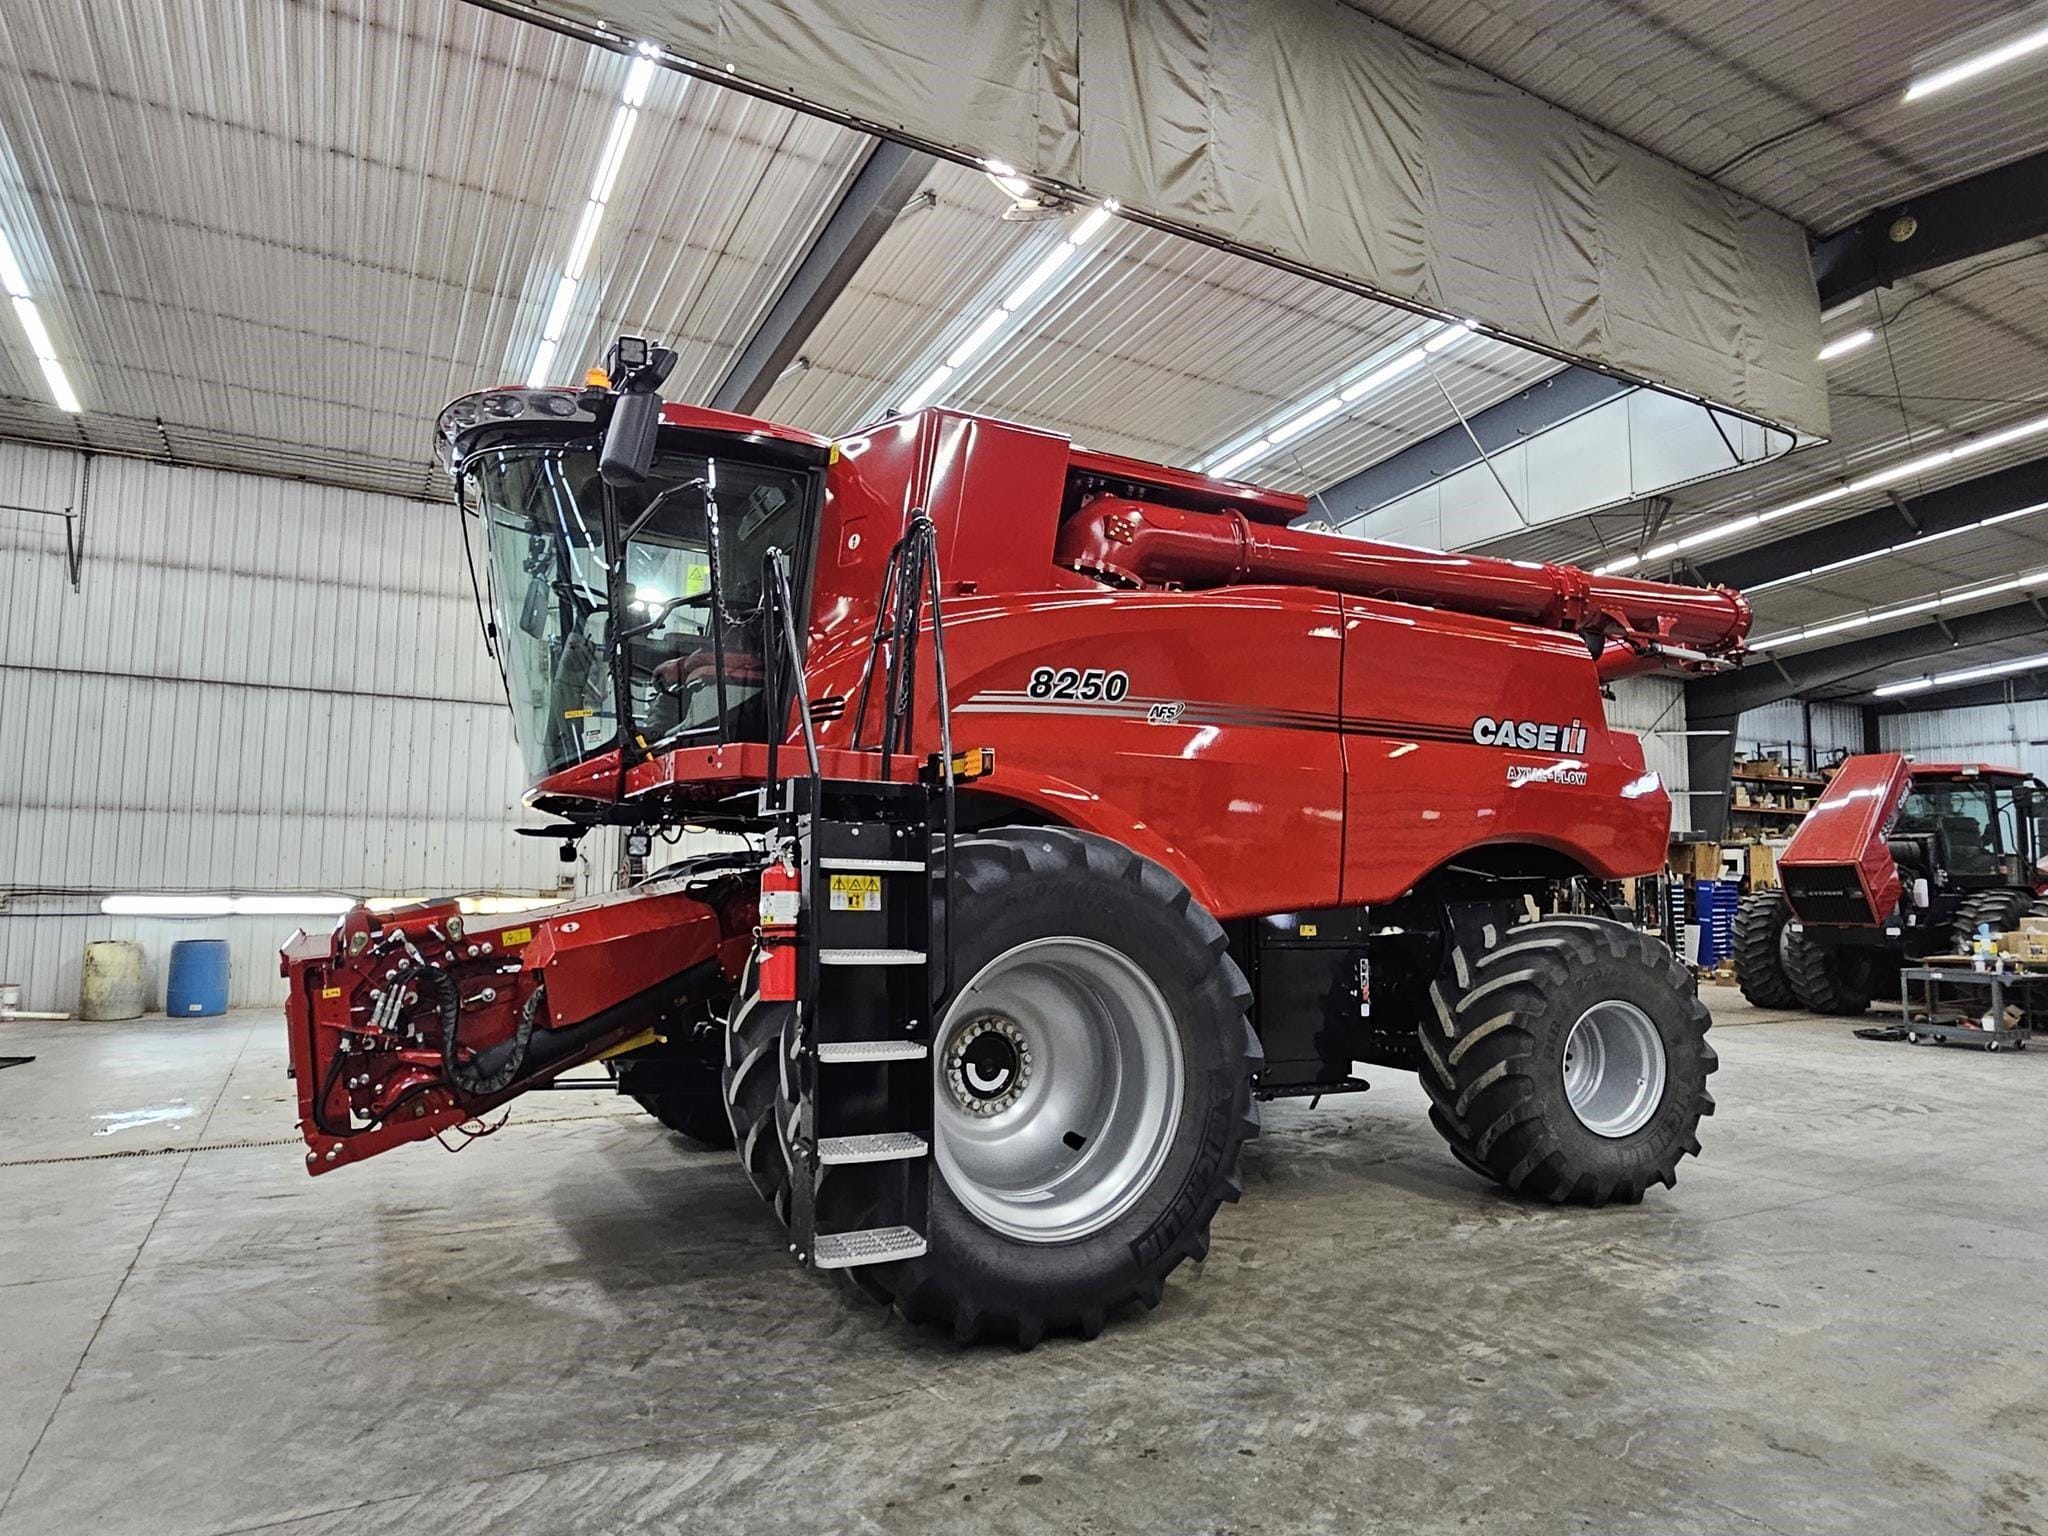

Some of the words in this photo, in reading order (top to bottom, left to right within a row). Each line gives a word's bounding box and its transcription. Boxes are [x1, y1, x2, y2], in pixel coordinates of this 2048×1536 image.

[1028, 667, 1128, 702] 8250
[1149, 703, 1177, 720] AFS
[1473, 717, 1558, 752] CASE
